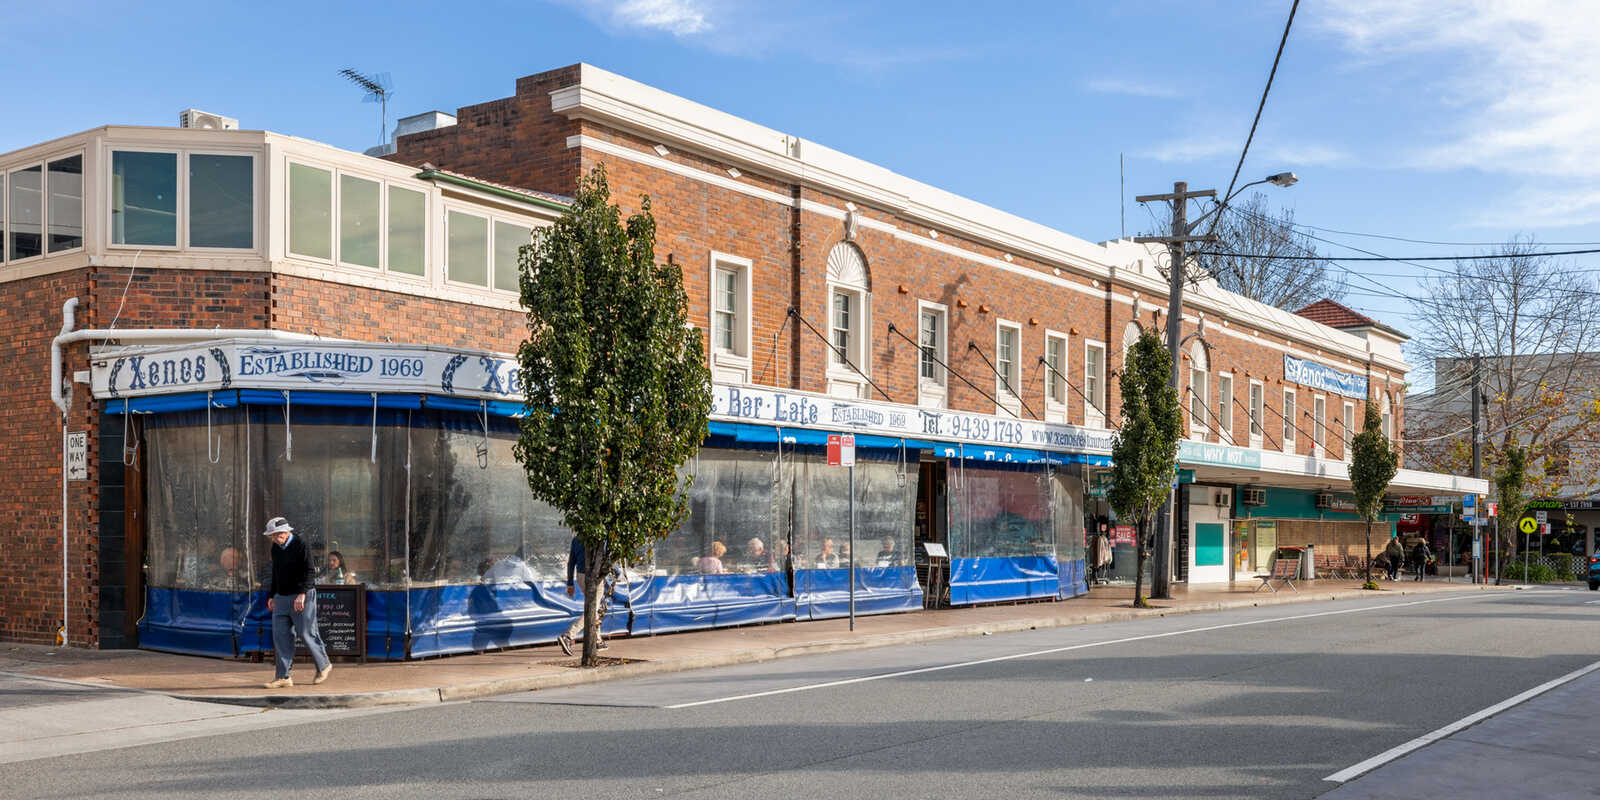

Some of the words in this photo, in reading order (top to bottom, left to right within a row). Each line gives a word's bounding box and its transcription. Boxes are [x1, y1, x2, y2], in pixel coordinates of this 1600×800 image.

[128, 355, 206, 390] Xenos
[239, 352, 373, 376] ESTABLISHED
[380, 358, 424, 377] 1969
[728, 388, 763, 419] Bar
[774, 394, 818, 425] Cafe
[70, 436, 84, 448] ONE
[952, 415, 989, 440] 9439
[993, 421, 1023, 444] 1748
[70, 451, 85, 462] WAY
